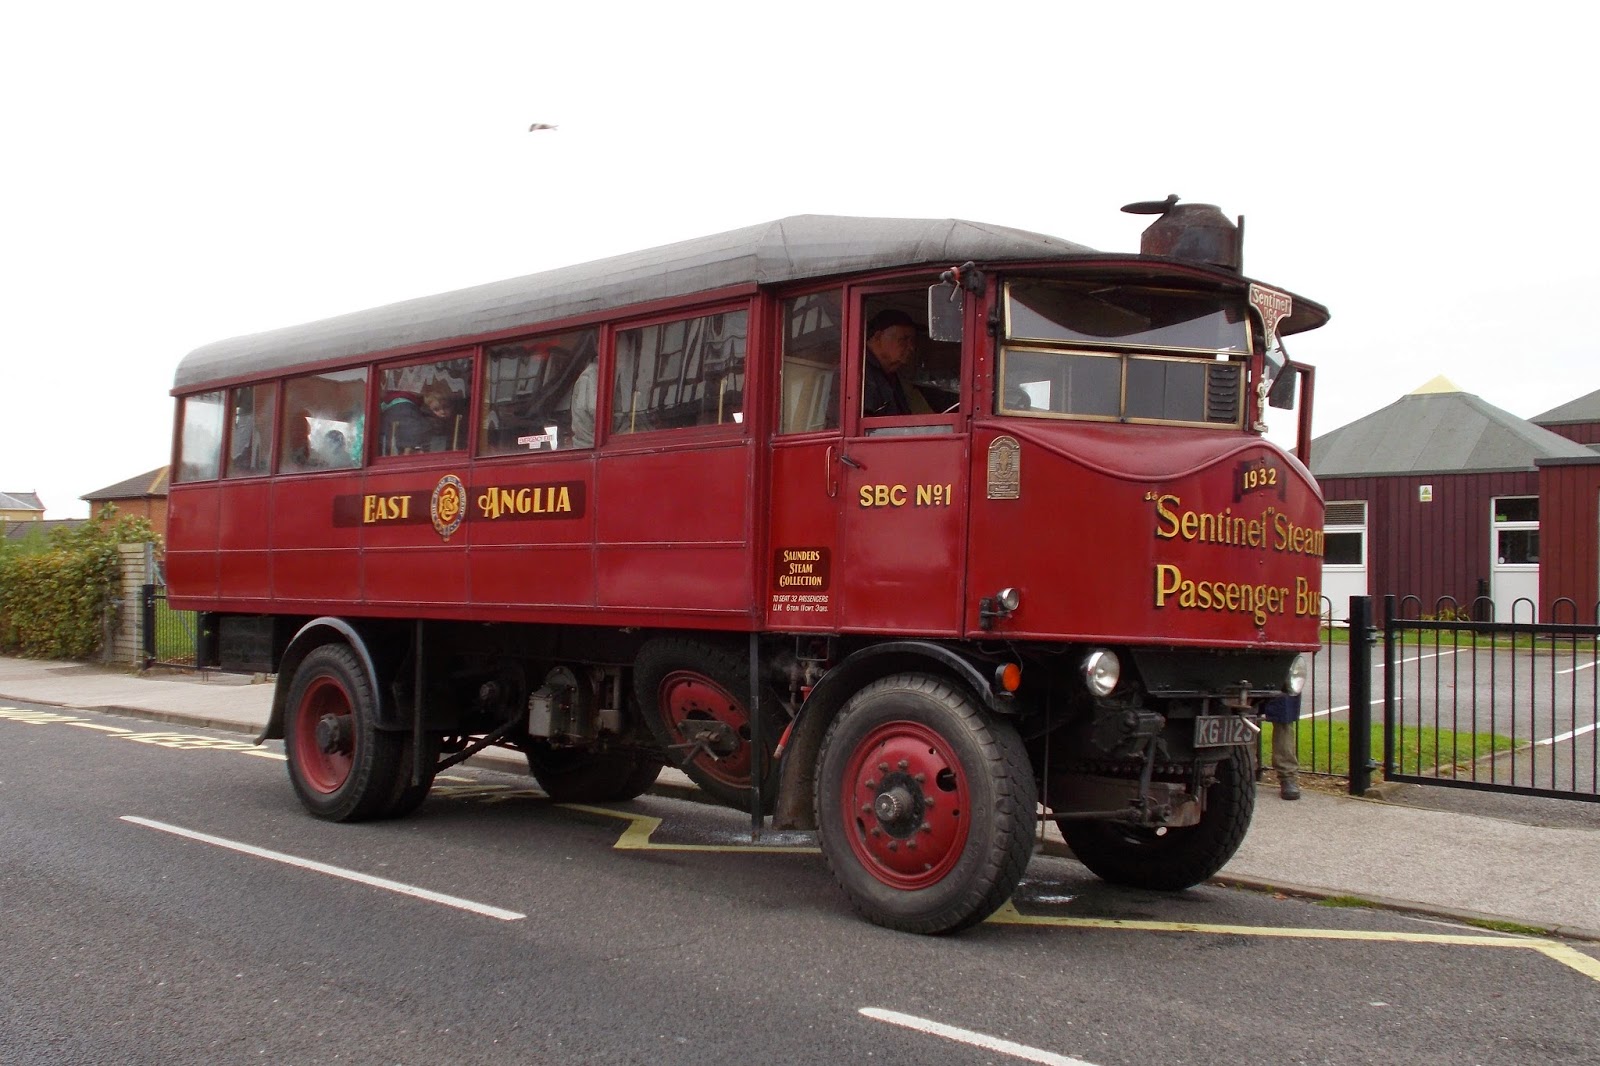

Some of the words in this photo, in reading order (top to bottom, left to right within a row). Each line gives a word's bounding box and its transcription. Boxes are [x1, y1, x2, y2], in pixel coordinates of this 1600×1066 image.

[1252, 288, 1289, 313] Sentinel
[1244, 467, 1277, 489] 1932
[363, 495, 411, 523] EAST
[478, 486, 572, 520] ANGLIA
[860, 484, 908, 507] SBC
[1273, 512, 1324, 557] Steam
[783, 550, 820, 562] SAUNDERS
[789, 562, 813, 574] STEAM
[779, 575, 822, 587] COLLECTION
[798, 595, 829, 603] PASSENGERS
[1156, 564, 1290, 626] Passenger
[1199, 719, 1219, 743] KG
